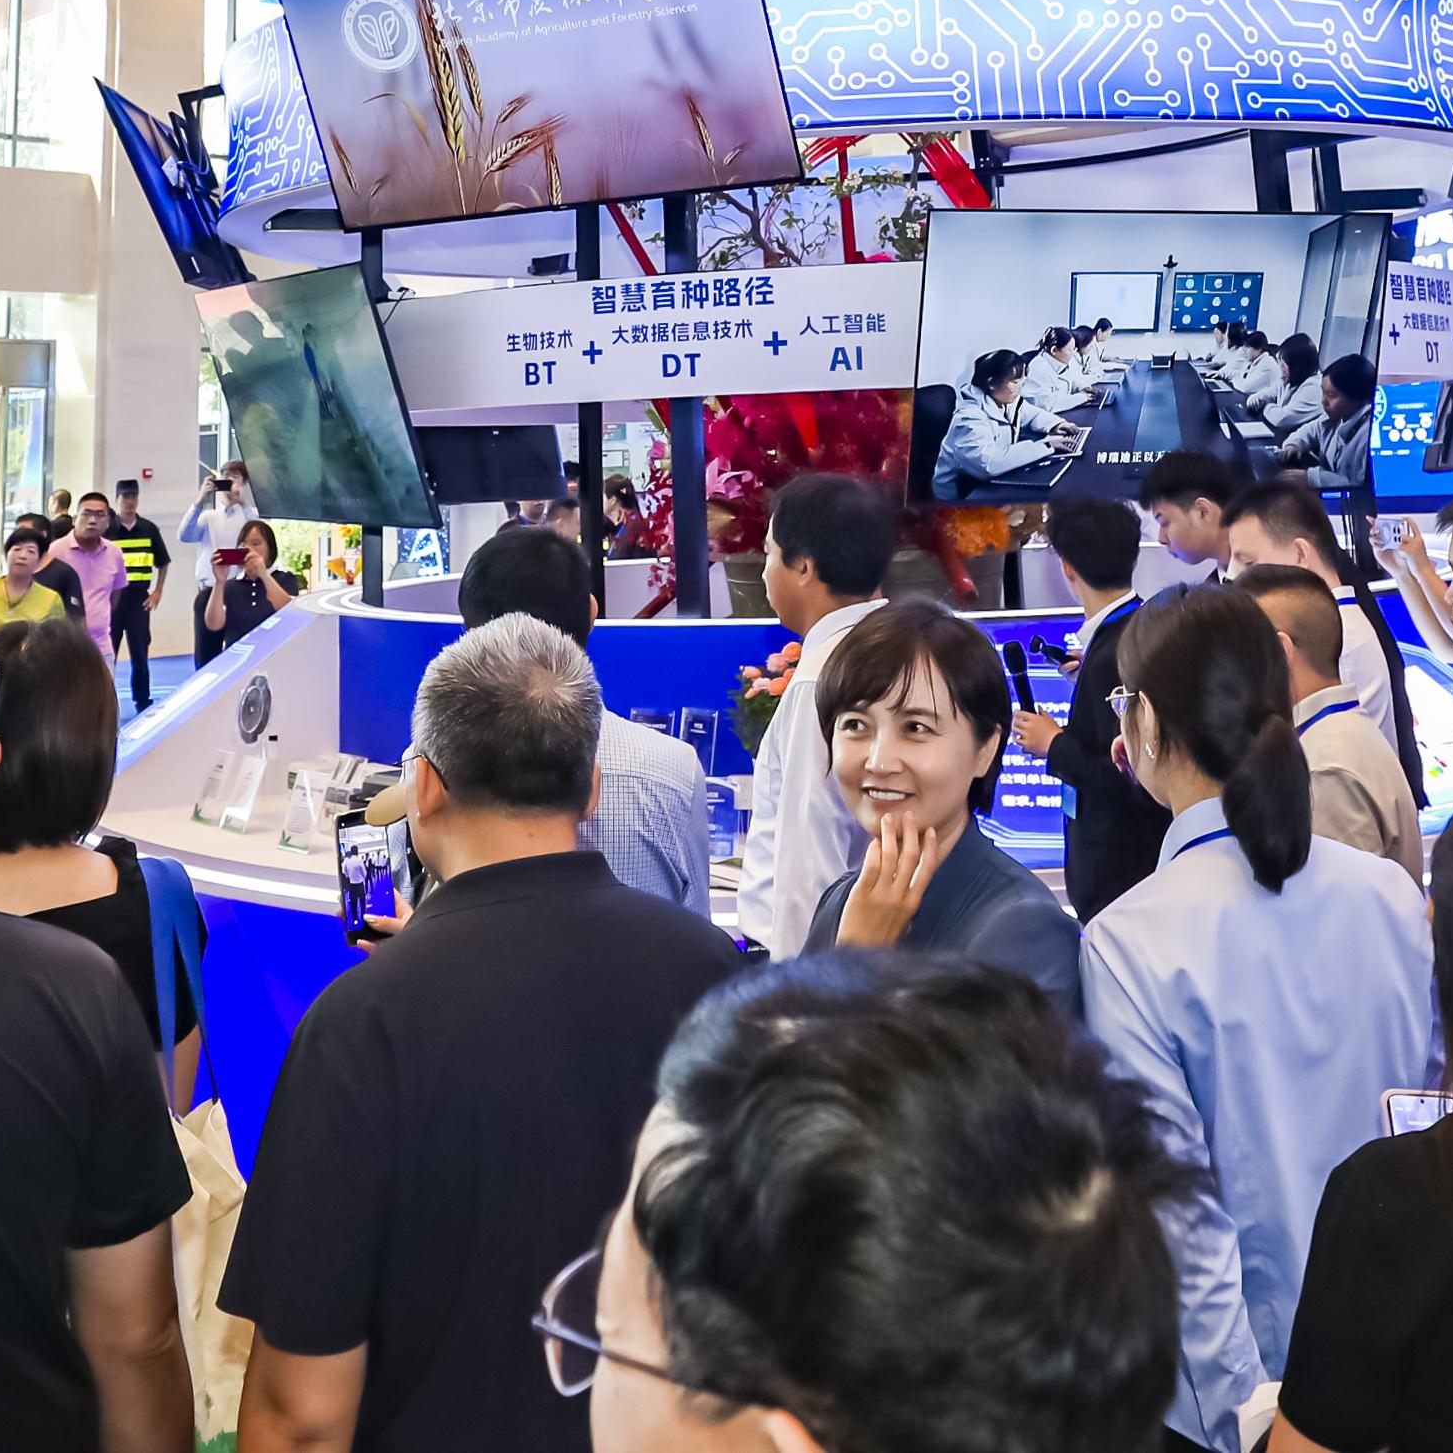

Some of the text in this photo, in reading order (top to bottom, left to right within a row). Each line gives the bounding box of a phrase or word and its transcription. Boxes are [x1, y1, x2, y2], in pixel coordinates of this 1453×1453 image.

[476, 30, 519, 43] Academy
[535, 20, 588, 35] Agriculture
[590, 15, 609, 26] and
[612, 10, 652, 23] Forestry
[654, 3, 698, 17] Sciences
[591, 276, 774, 314] 智慧育种路径
[506, 330, 573, 352] 生物技术
[611, 319, 753, 345] 大数据信息技术
[799, 314, 886, 336] 人工智能
[1426, 341, 1439, 363] DT
[524, 346, 863, 386] BT DT AI
